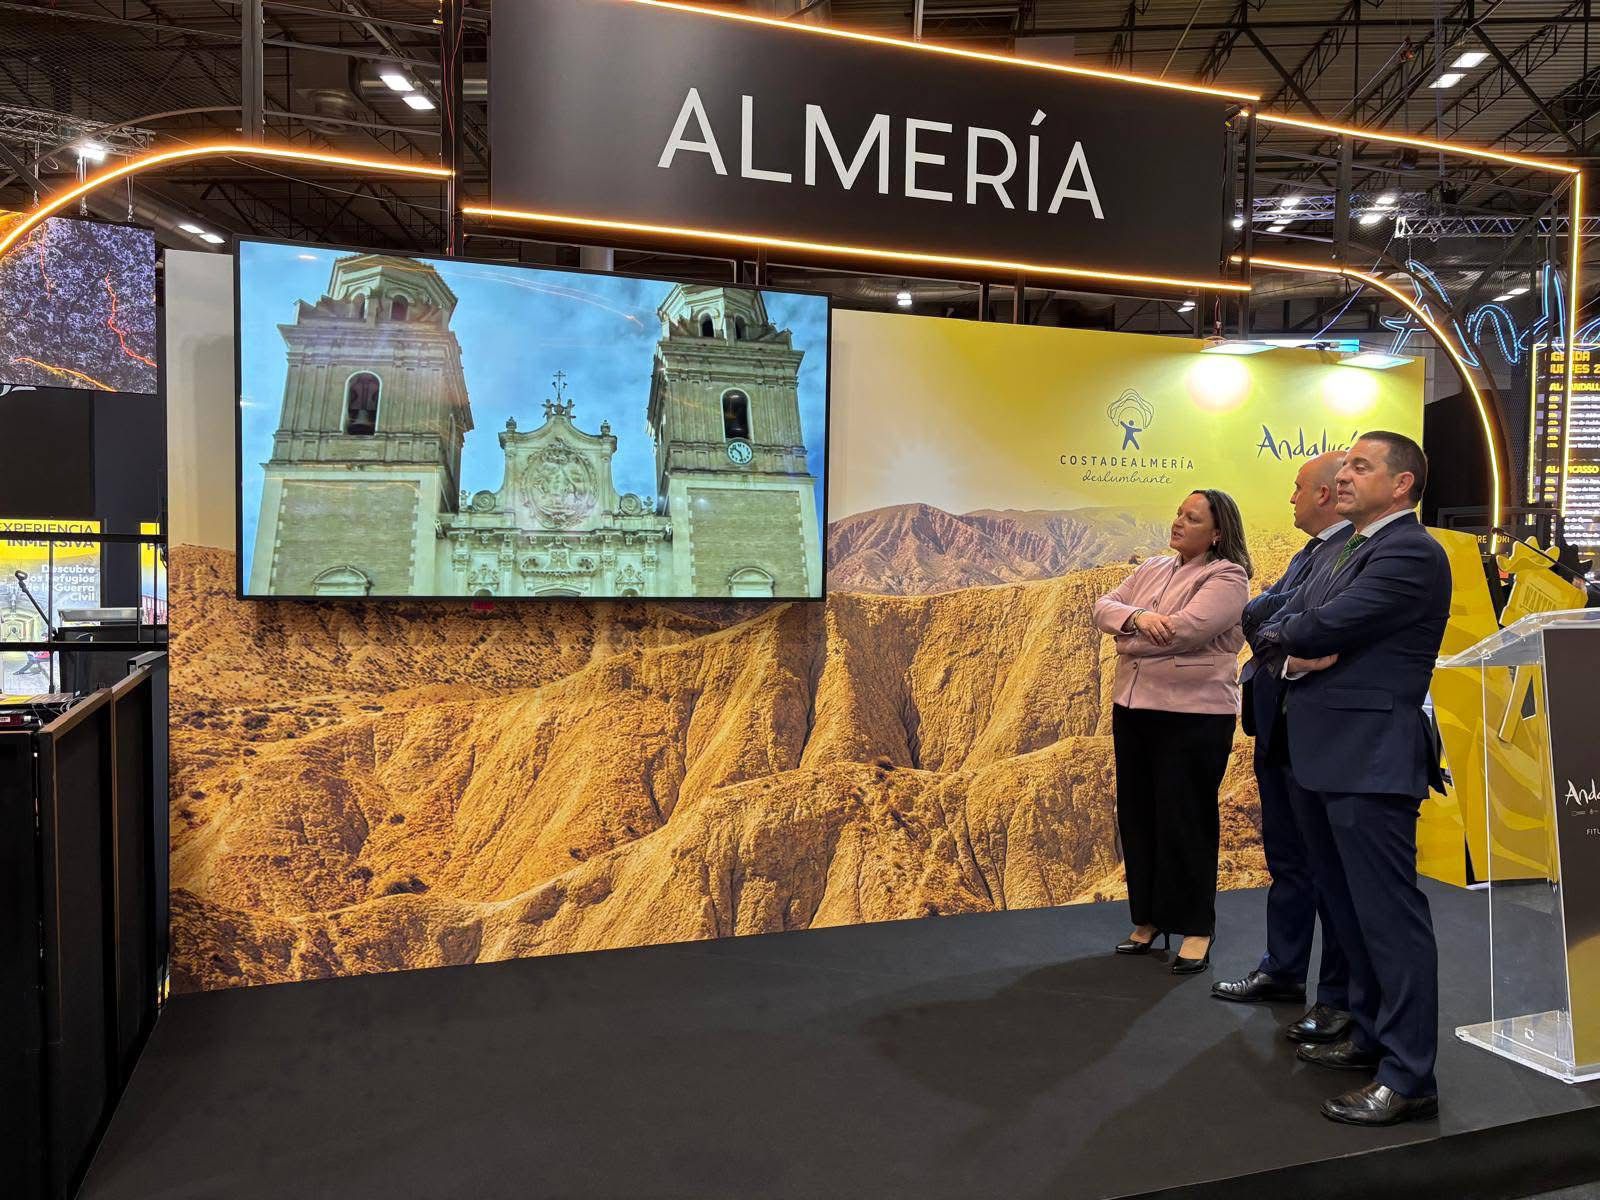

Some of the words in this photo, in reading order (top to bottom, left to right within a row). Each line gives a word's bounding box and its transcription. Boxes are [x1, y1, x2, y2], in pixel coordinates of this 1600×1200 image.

[657, 87, 1105, 219] ALMERÍA
[1545, 351, 1590, 361] GEDA
[1550, 364, 1590, 374] UEES
[1256, 424, 1358, 461] Andaluc
[1082, 470, 1172, 484] deslumbrante
[42, 565, 95, 573] Descubre
[55, 583, 95, 592] Guerra
[71, 592, 95, 601] Civil
